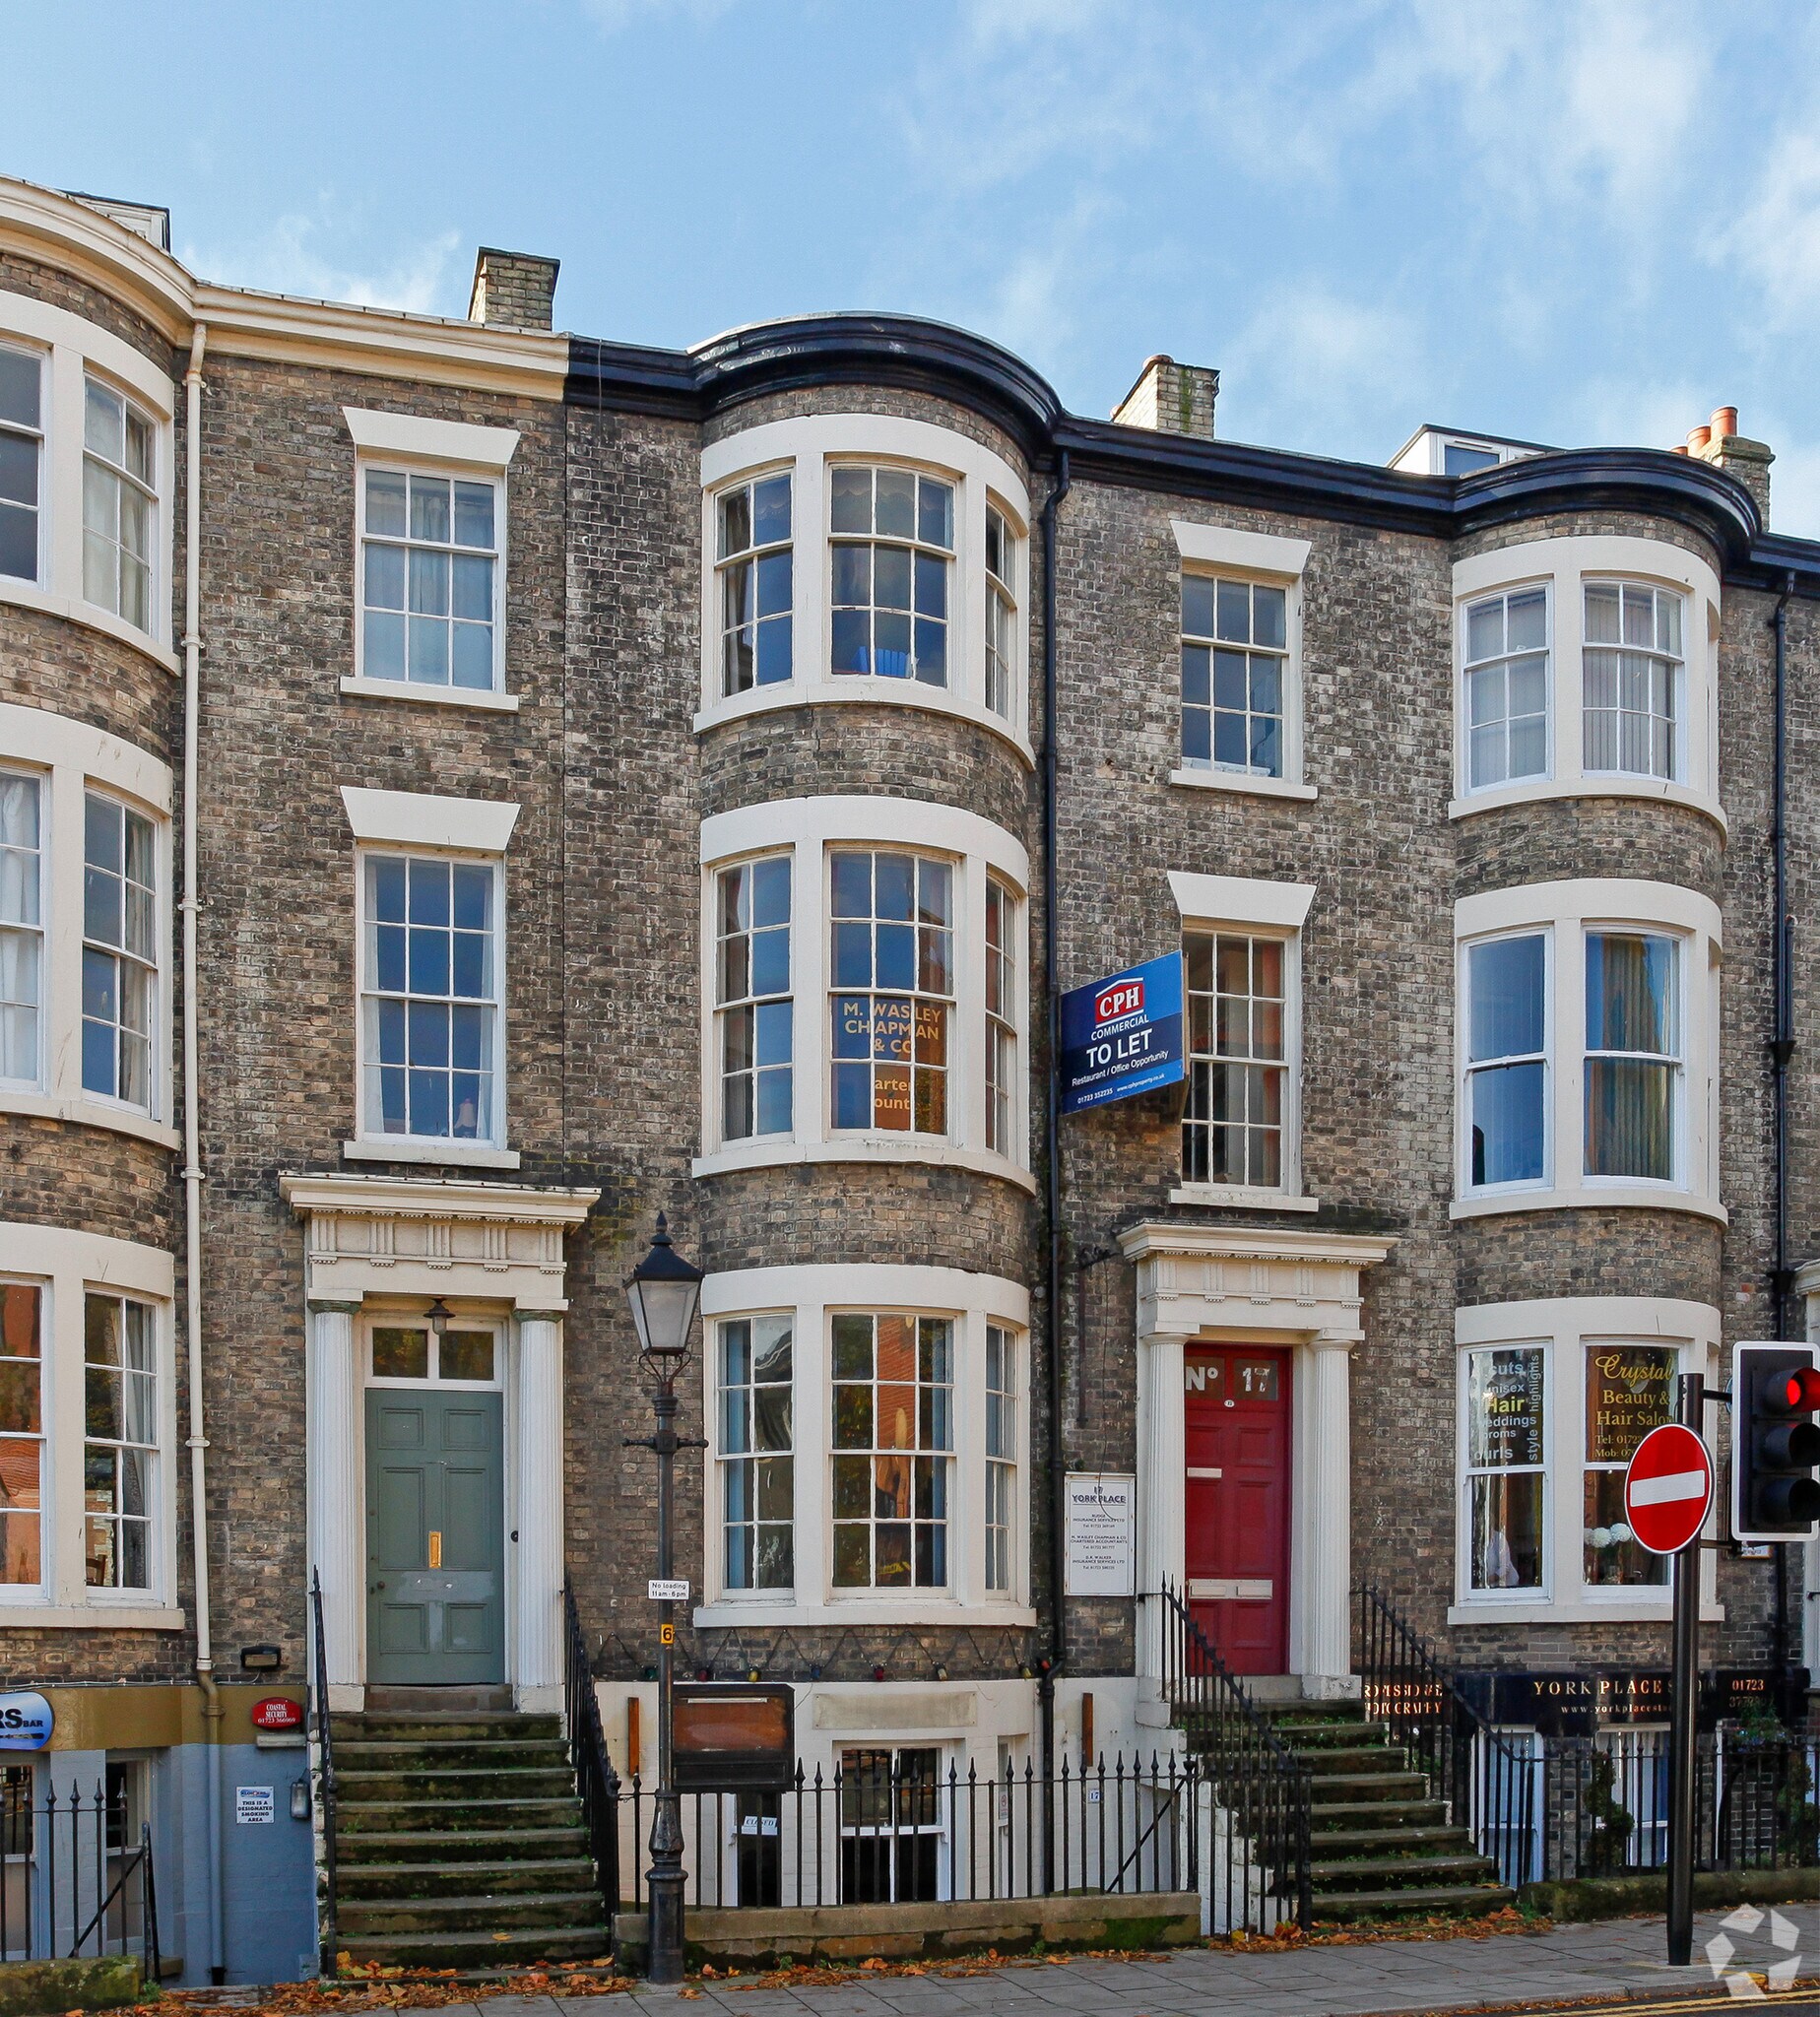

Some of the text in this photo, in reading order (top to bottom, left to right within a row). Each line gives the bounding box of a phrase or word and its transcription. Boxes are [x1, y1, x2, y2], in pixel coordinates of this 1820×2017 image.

[1100, 986, 1139, 1017] CPH
[843, 1002, 941, 1023] M. WASLEY
[845, 1020, 939, 1040] CHAPMAN
[1091, 1014, 1149, 1041] COMMERCIAL
[875, 1039, 884, 1052] &
[1086, 1028, 1152, 1069] TO LET
[1072, 1071, 1106, 1087] Restaurant
[1111, 1063, 1130, 1074] Office
[1131, 1050, 1169, 1068] Opportunity
[1595, 1354, 1674, 1388] Crystal
[1528, 1354, 1541, 1412] highlights
[1602, 1389, 1670, 1409] Beauty &
[1484, 1415, 1537, 1428] eddings
[1596, 1409, 1633, 1426] Hair
[1528, 1429, 1541, 1462] style
[1072, 1494, 1127, 1504] YORK PLACE
[663, 1627, 673, 1642] 6
[1533, 1680, 1592, 1695] YORK
[1599, 1679, 1662, 1695] PLACE
[1731, 1679, 1765, 1691] 01723
